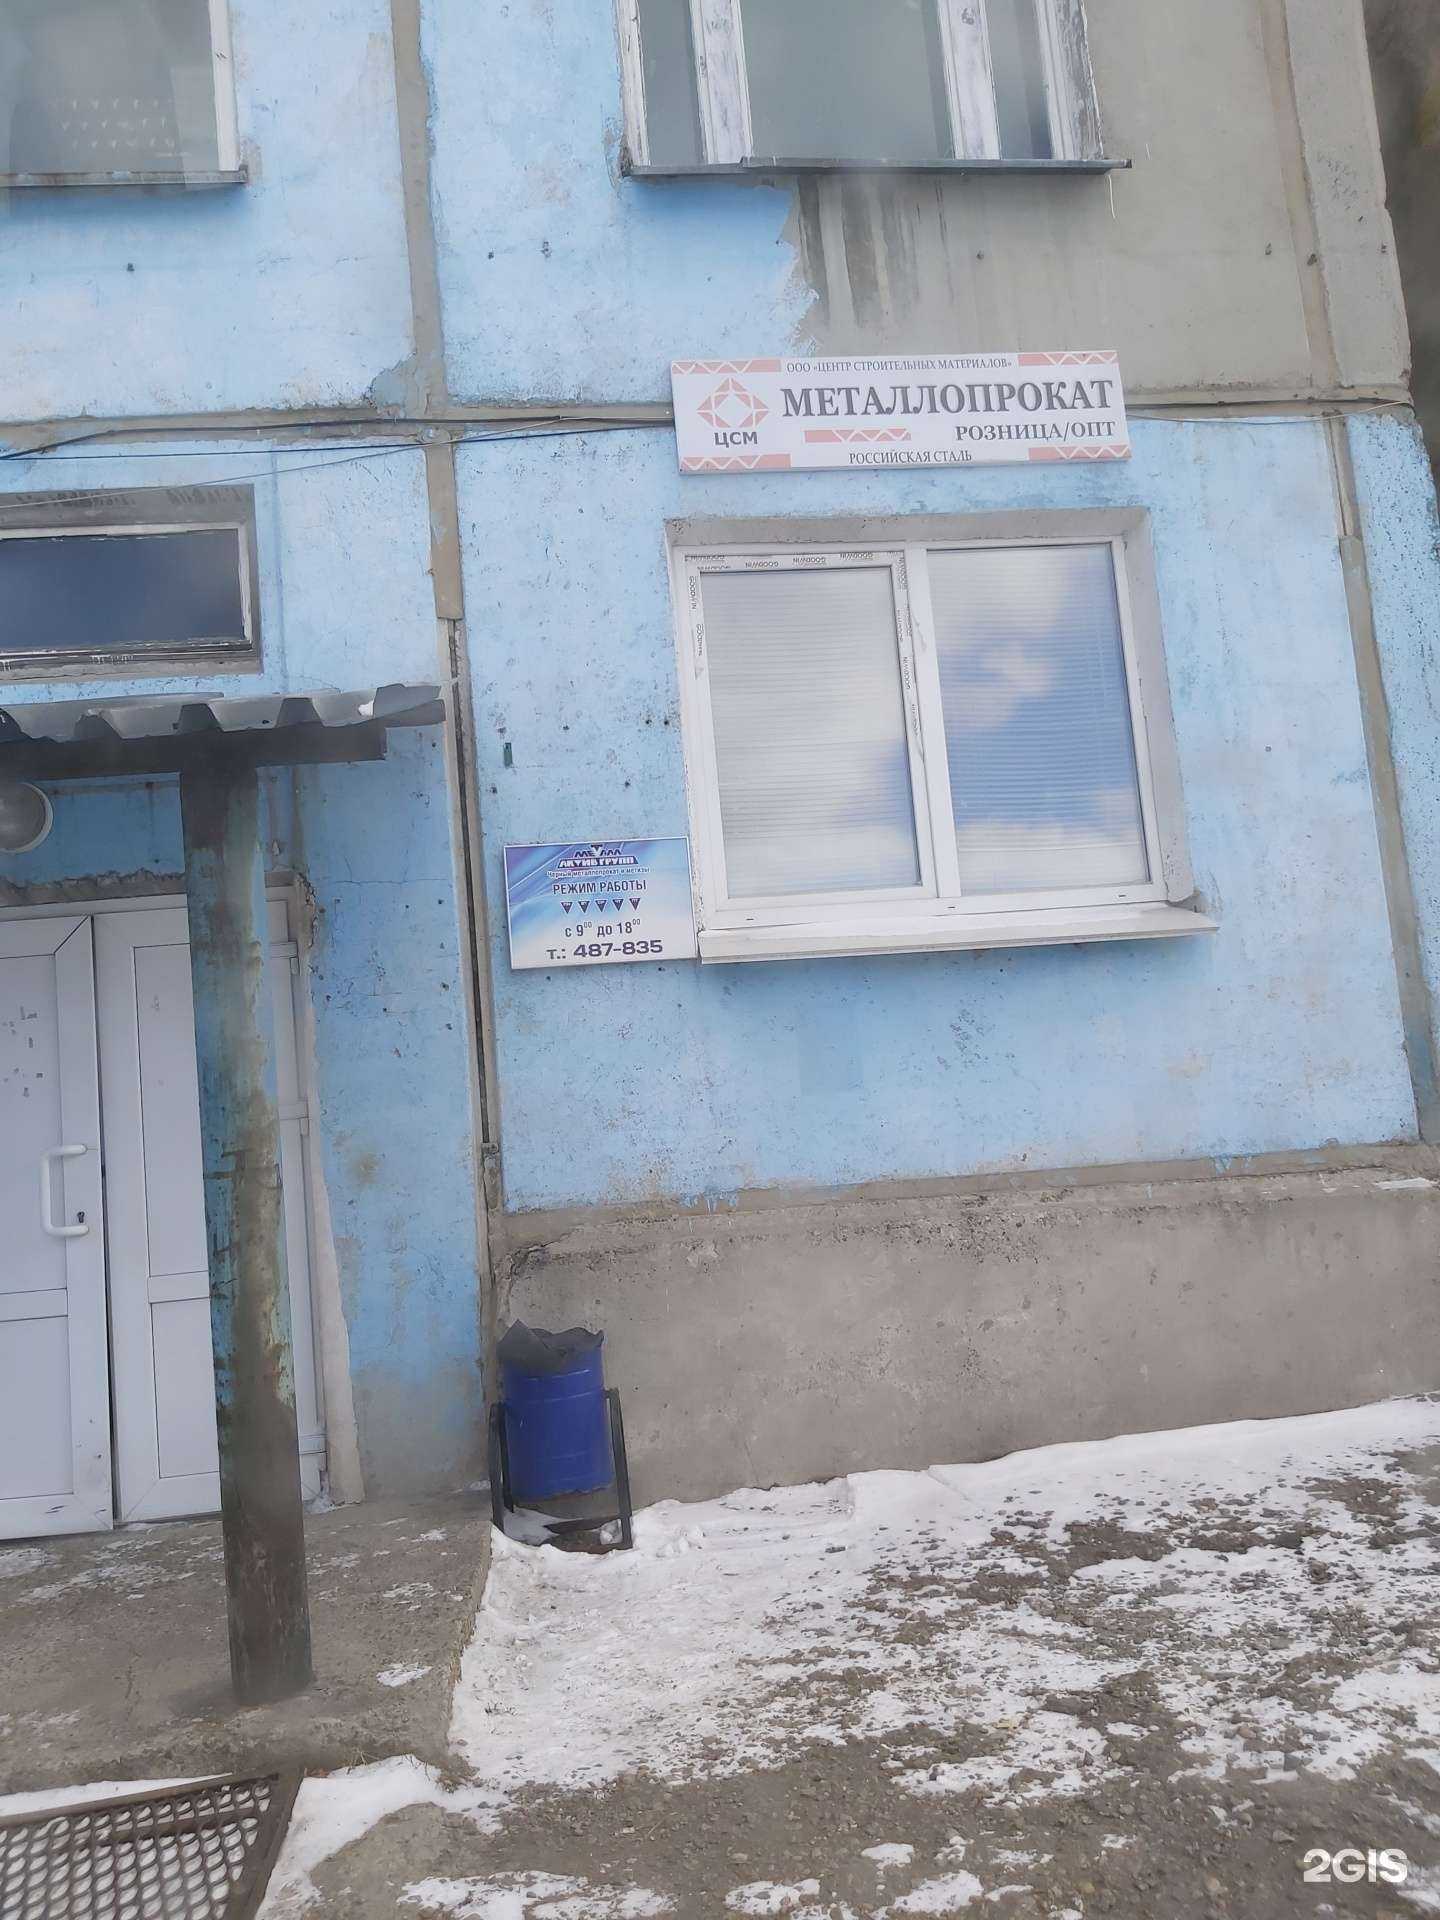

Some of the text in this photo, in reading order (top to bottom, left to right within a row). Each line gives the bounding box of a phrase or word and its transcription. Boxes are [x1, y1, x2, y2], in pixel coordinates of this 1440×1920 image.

[786, 362, 811, 373] ООО
[853, 359, 937, 372] СТРОИТЕЛЬНЫХ
[780, 379, 1114, 418] МЕТАЛЛОПРОКАТ
[714, 431, 758, 449] ЦСМ
[955, 421, 1116, 442] РОЗНИЦА/ОПТ
[849, 449, 972, 465] РОССИЙСКАЯ СТАЛЬ
[553, 879, 647, 894] РЕЖИМ РАБОТЫ
[597, 925, 612, 937] до
[574, 940, 663, 958] 487-835
